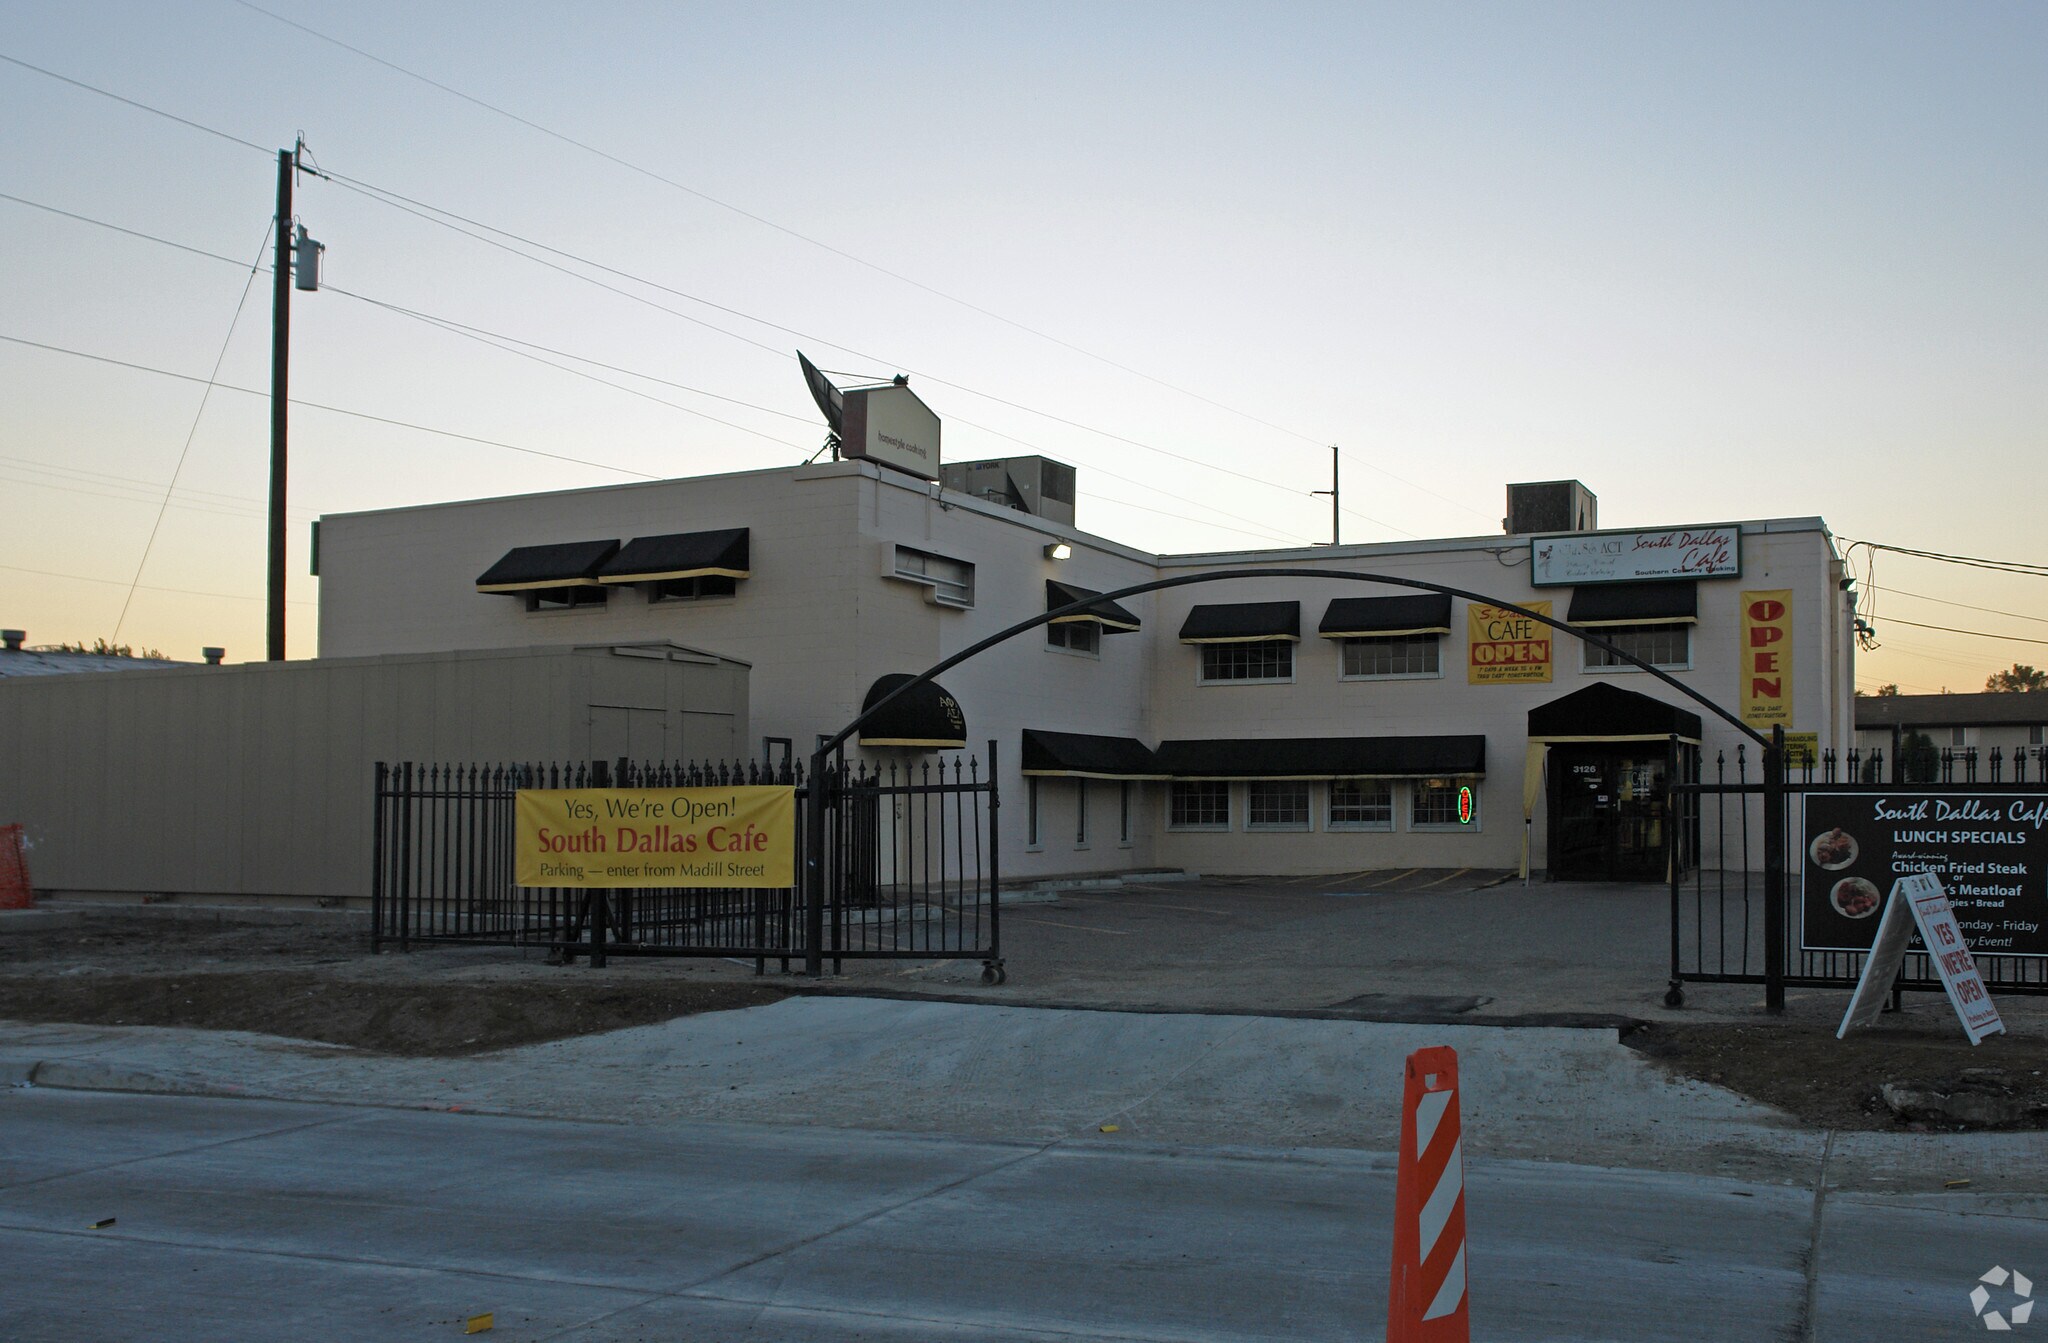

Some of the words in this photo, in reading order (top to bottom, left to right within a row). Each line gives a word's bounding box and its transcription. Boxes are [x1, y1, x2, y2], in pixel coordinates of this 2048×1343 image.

[1632, 532, 1676, 551] South
[1678, 530, 1732, 549] Dallas
[1682, 544, 1730, 573] Cafe
[1488, 620, 1532, 641] CAFE
[1475, 643, 1546, 663] OPEN
[1748, 600, 1785, 699] OPEN
[1573, 765, 1597, 773] 3126
[565, 798, 598, 822] Yes,
[605, 797, 664, 818] We're
[671, 797, 736, 824] Open!
[1875, 799, 1928, 821] South
[1936, 799, 2001, 821] Dallas
[538, 826, 606, 853] South
[617, 825, 697, 853] Dallas
[706, 824, 768, 852] Cafe
[1893, 831, 1947, 843] LUNCH
[1951, 831, 2026, 844] SPECIALS
[1892, 851, 1948, 861] Award-winning
[540, 863, 584, 880] Parking
[607, 864, 642, 877] enter
[644, 863, 675, 877] from
[680, 862, 722, 877] Madill
[727, 863, 765, 877] Street
[1892, 862, 1946, 873] Chicken
[1949, 862, 1984, 874] Fried
[1988, 863, 2028, 875] Steak
[1959, 884, 2023, 896] Meatloaf
[1976, 899, 2005, 908] Bread
[1933, 922, 1956, 946] YES
[1957, 920, 1993, 932] onday
[2003, 920, 2039, 933] Friday
[1978, 936, 2013, 947] Event!
[1956, 977, 1985, 1004] OPEN
